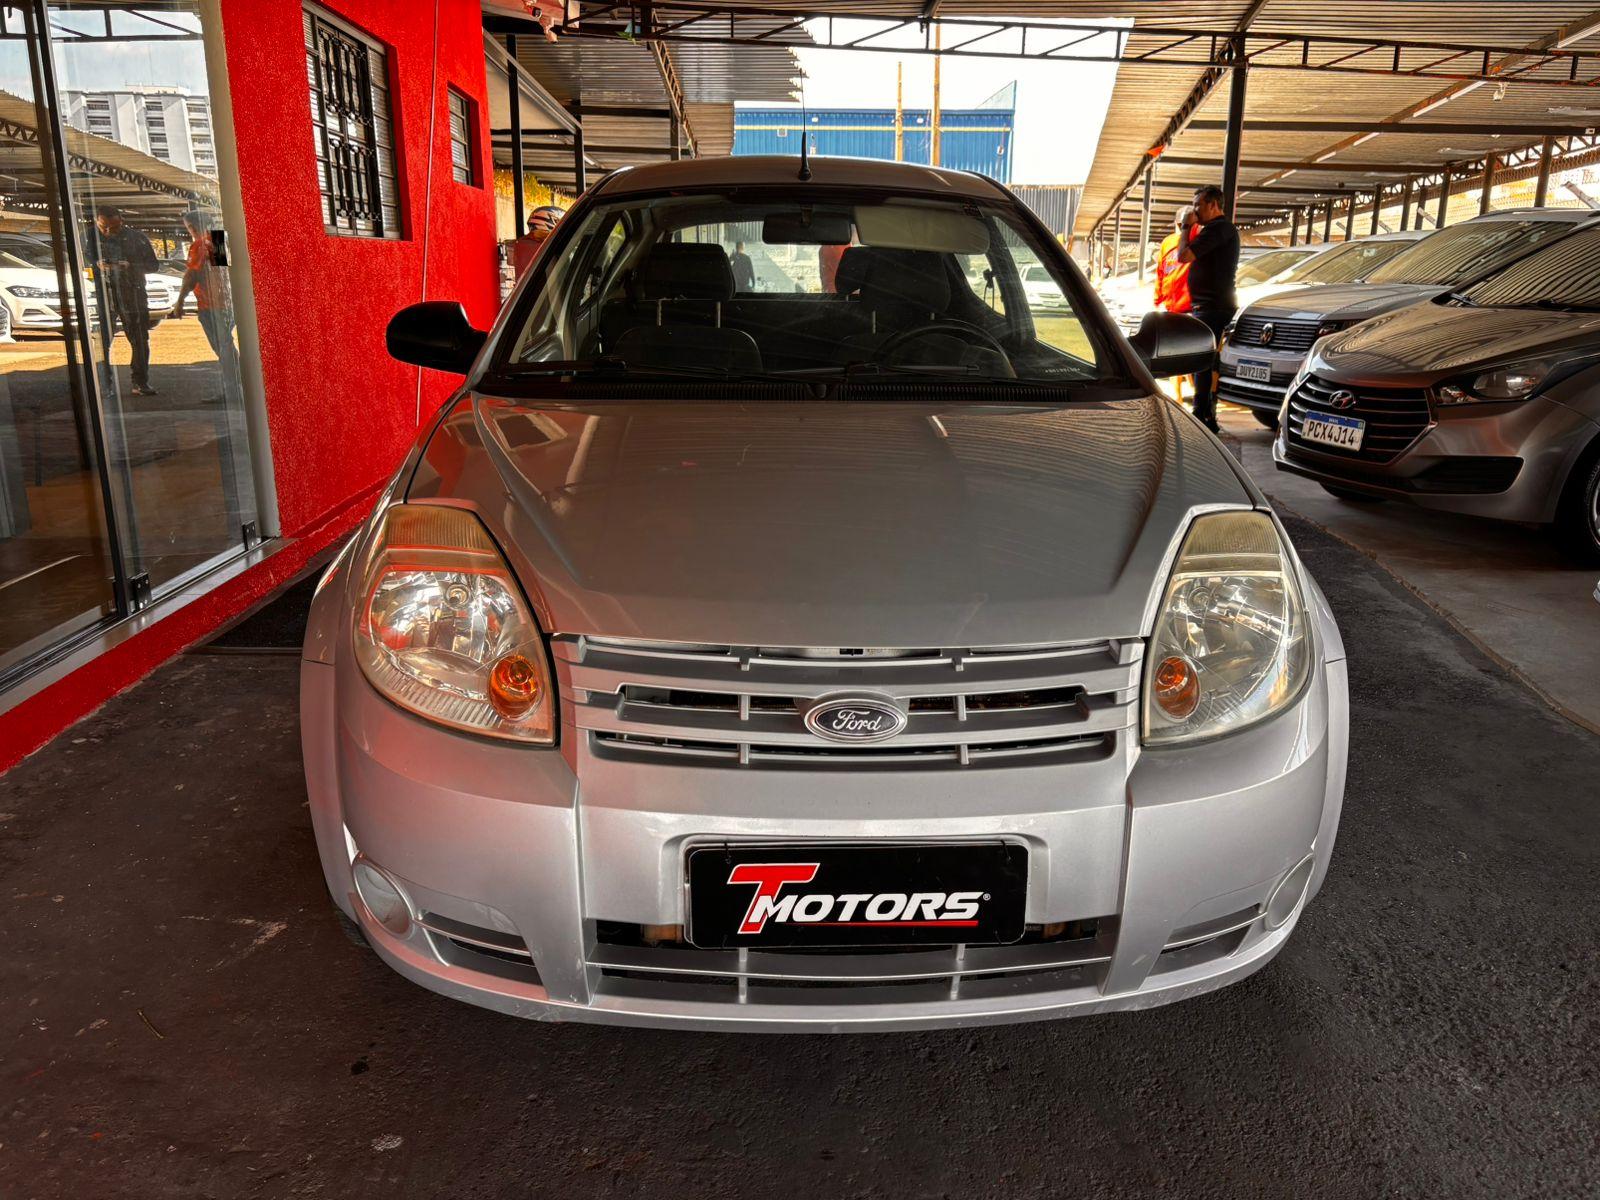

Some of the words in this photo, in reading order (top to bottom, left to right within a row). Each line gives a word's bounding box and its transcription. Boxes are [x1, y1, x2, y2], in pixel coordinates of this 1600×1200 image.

[1307, 420, 1355, 446] PCX4J14
[832, 709, 882, 731] Ford
[748, 891, 984, 923] MOTORS
